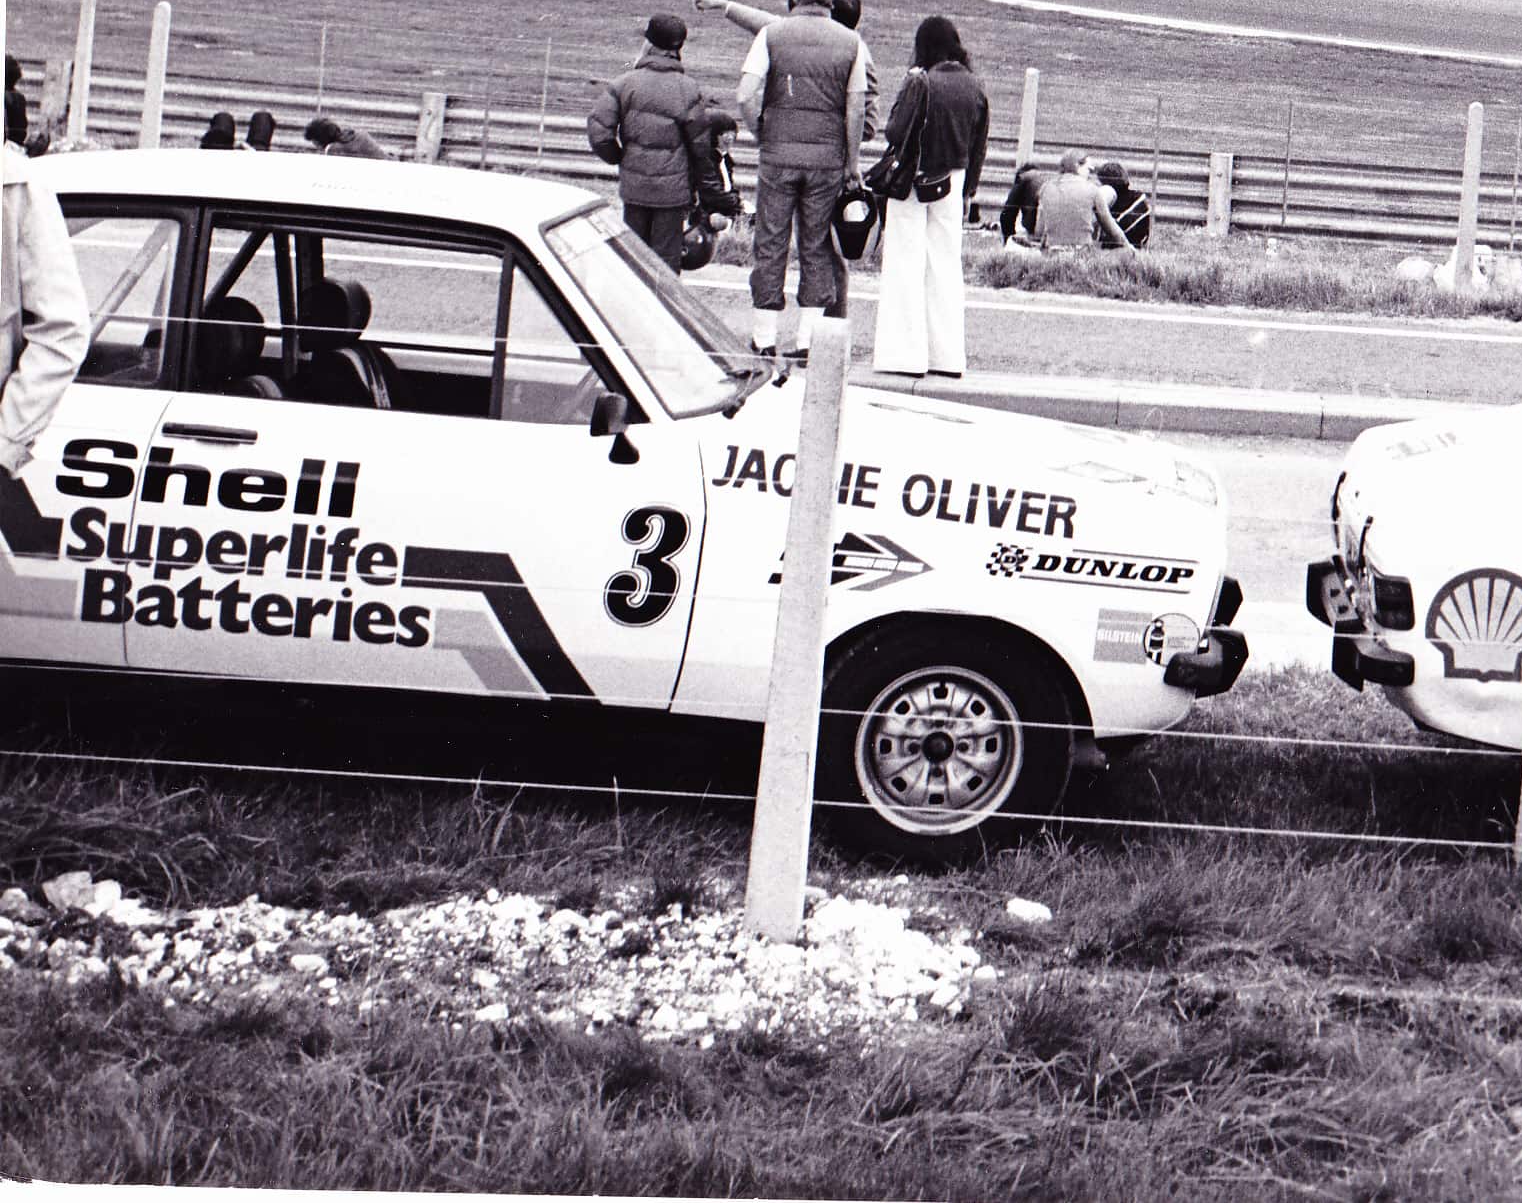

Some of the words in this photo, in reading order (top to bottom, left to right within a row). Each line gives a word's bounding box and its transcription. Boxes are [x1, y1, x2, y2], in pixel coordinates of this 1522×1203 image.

[55, 438, 361, 518] Shell
[711, 444, 883, 510] JACIE
[901, 472, 1078, 540] OLIVER
[66, 507, 399, 586] Superlife
[603, 503, 691, 628] 3
[1031, 554, 1195, 584] DUNLOP
[81, 568, 431, 648] Batteries
